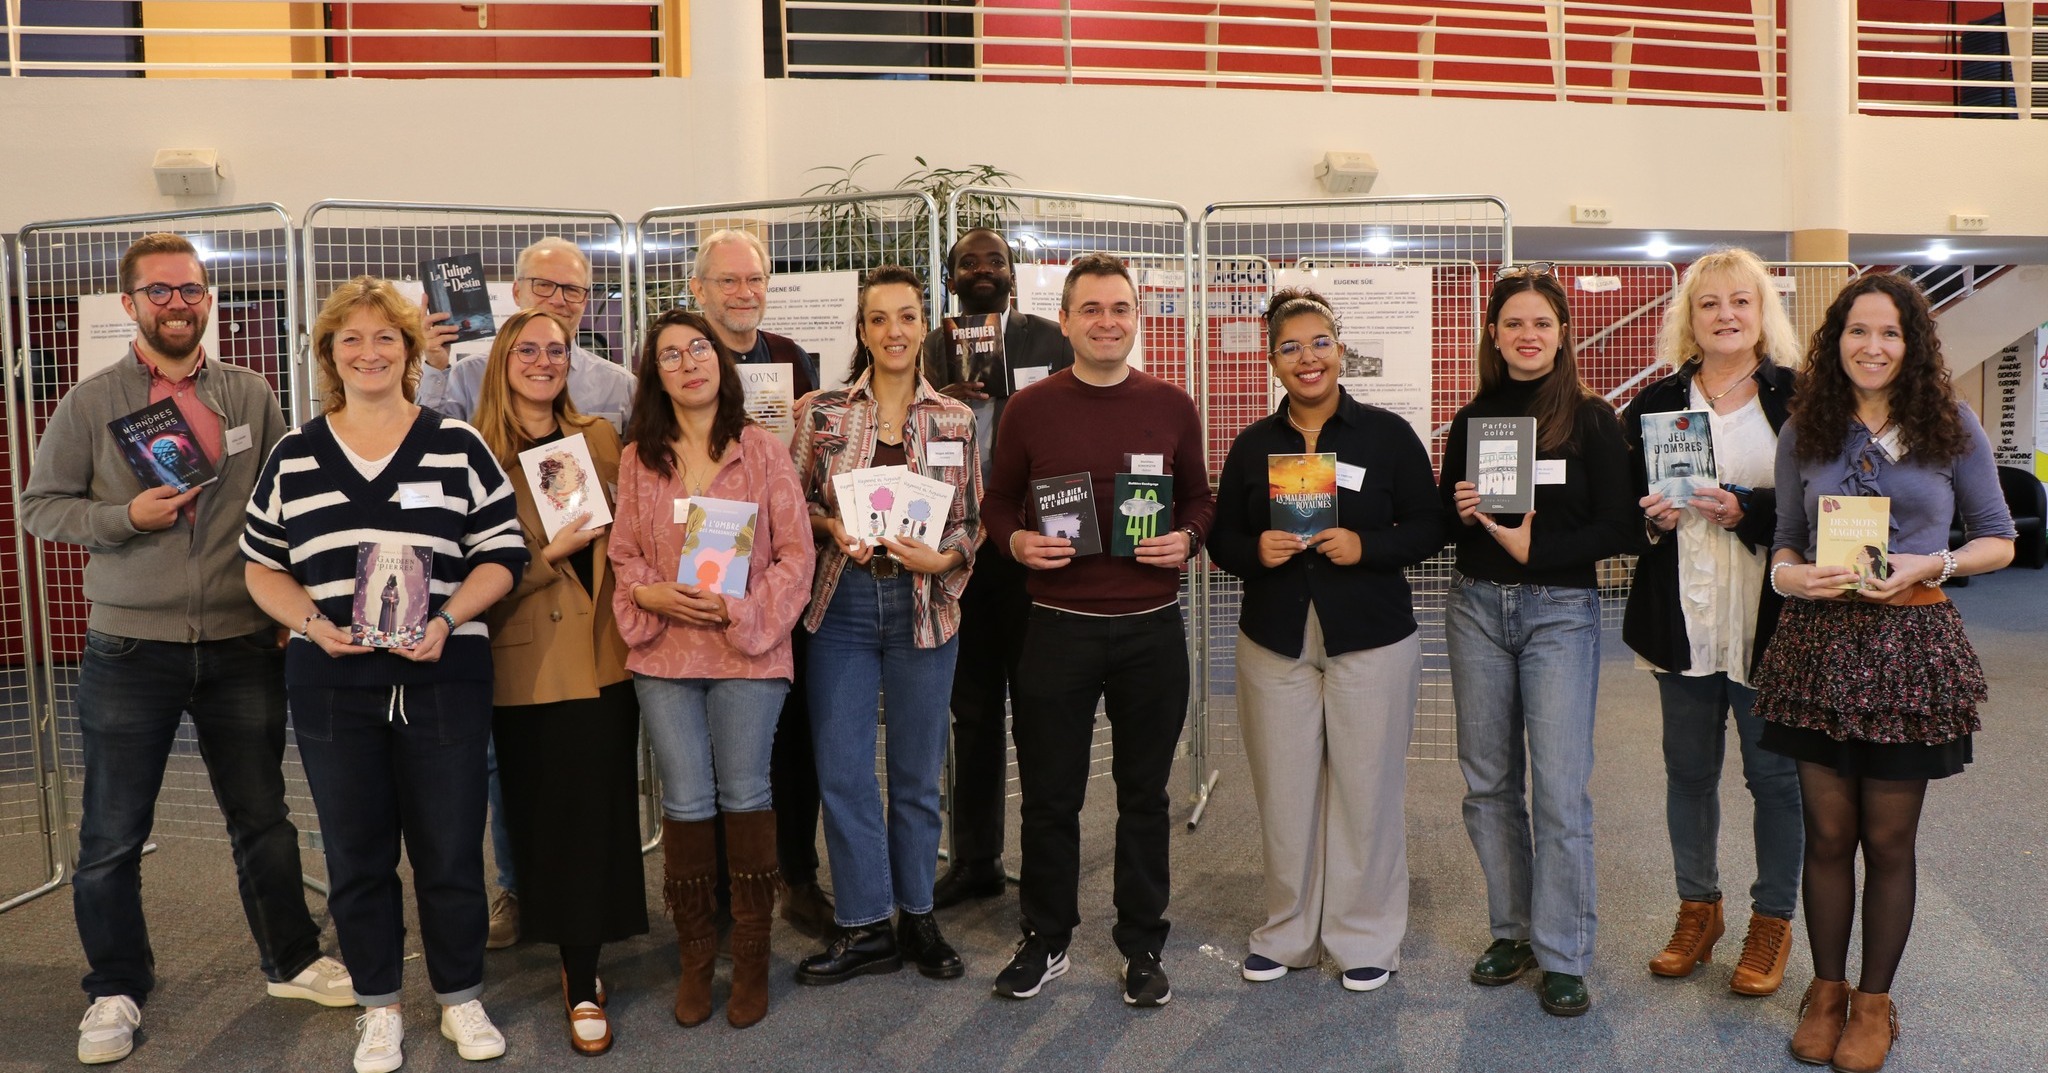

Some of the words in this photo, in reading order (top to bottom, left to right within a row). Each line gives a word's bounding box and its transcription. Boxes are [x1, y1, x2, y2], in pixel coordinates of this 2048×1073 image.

[430, 271, 441, 282] La
[437, 262, 473, 280] Tulipe
[452, 277, 481, 293] Destin
[766, 286, 787, 294] UGENE
[789, 284, 801, 292] SÜE
[952, 326, 995, 340] PREMIER
[956, 341, 994, 355] ASSAUT
[750, 372, 778, 383] OVNI
[123, 408, 173, 435] MEANDRES
[128, 417, 178, 443] METAVERS
[1668, 431, 1686, 443] JEU
[1654, 442, 1702, 455] D'OMBRES
[1039, 493, 1055, 504] POUR
[1057, 490, 1065, 499] LE
[1067, 487, 1082, 497] BIEN
[1041, 502, 1049, 510] DE
[1051, 490, 1088, 508] L'HUMANITÉ
[1276, 494, 1284, 503] LA
[1284, 492, 1331, 502] MALÉDICTION
[1296, 500, 1332, 513] ROYAUMES
[709, 520, 740, 531] L'OMBRE
[1830, 518, 1849, 527] DES
[1850, 518, 1878, 527] MOTS
[1829, 528, 1878, 538] MAGIQUES
[377, 555, 415, 565] GARDIEN
[379, 563, 414, 571] PIERRES
